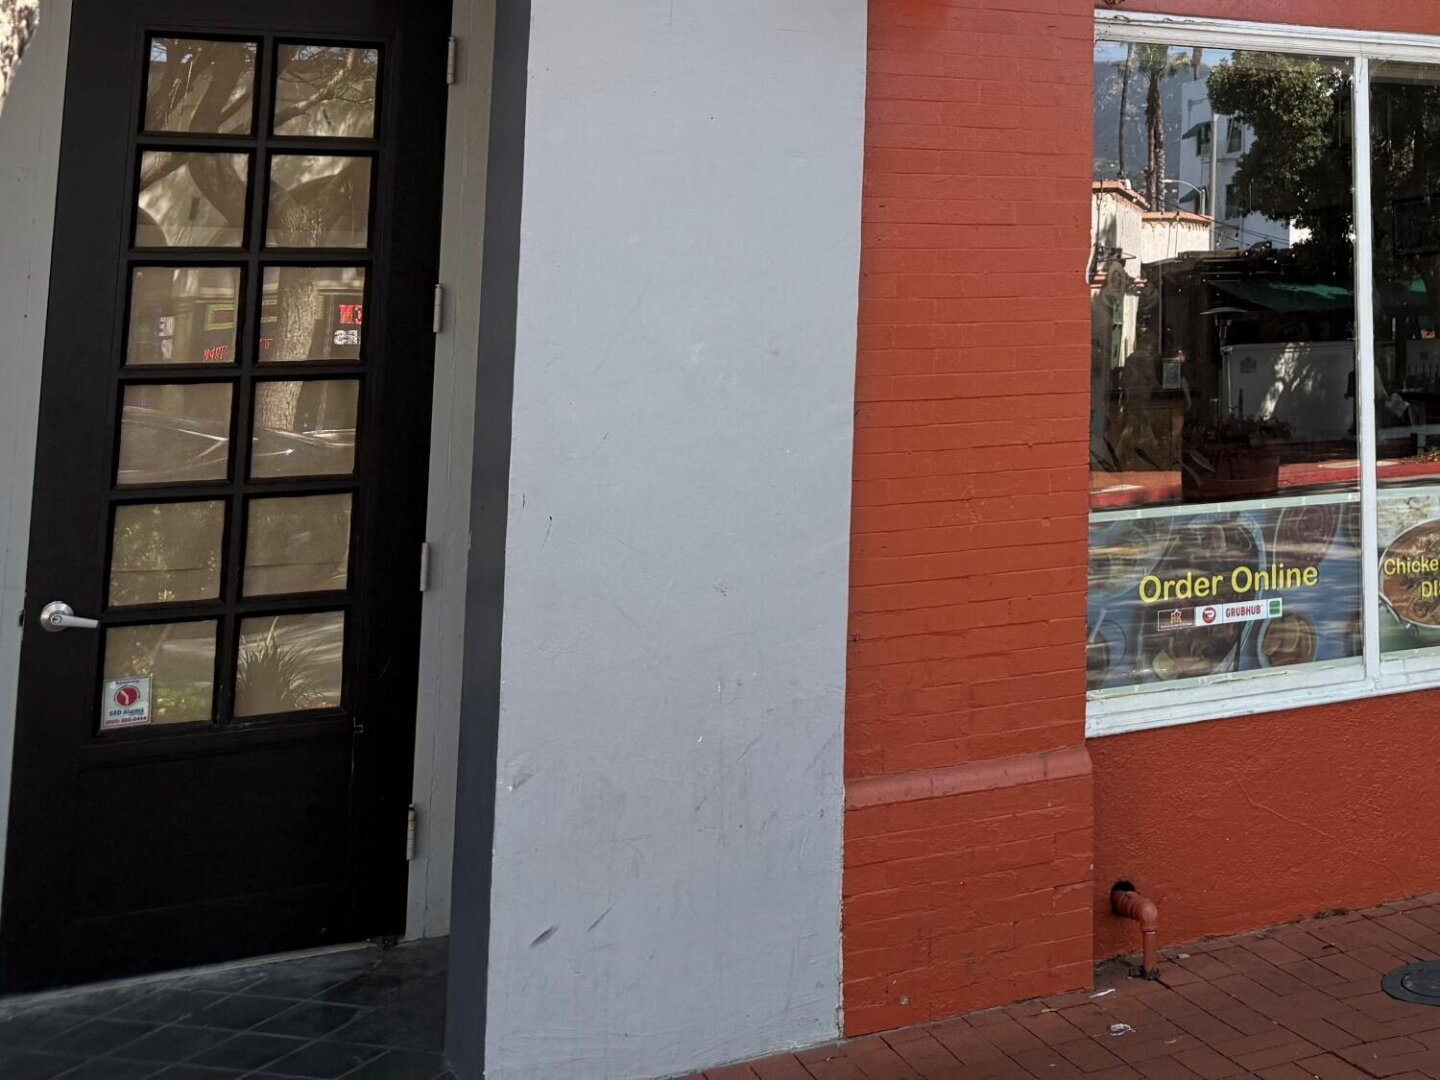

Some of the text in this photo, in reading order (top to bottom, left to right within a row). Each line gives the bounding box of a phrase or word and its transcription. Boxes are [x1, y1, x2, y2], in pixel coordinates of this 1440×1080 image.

[1138, 563, 1319, 604] Order Online
[1226, 604, 1262, 618] GRUBHUB
